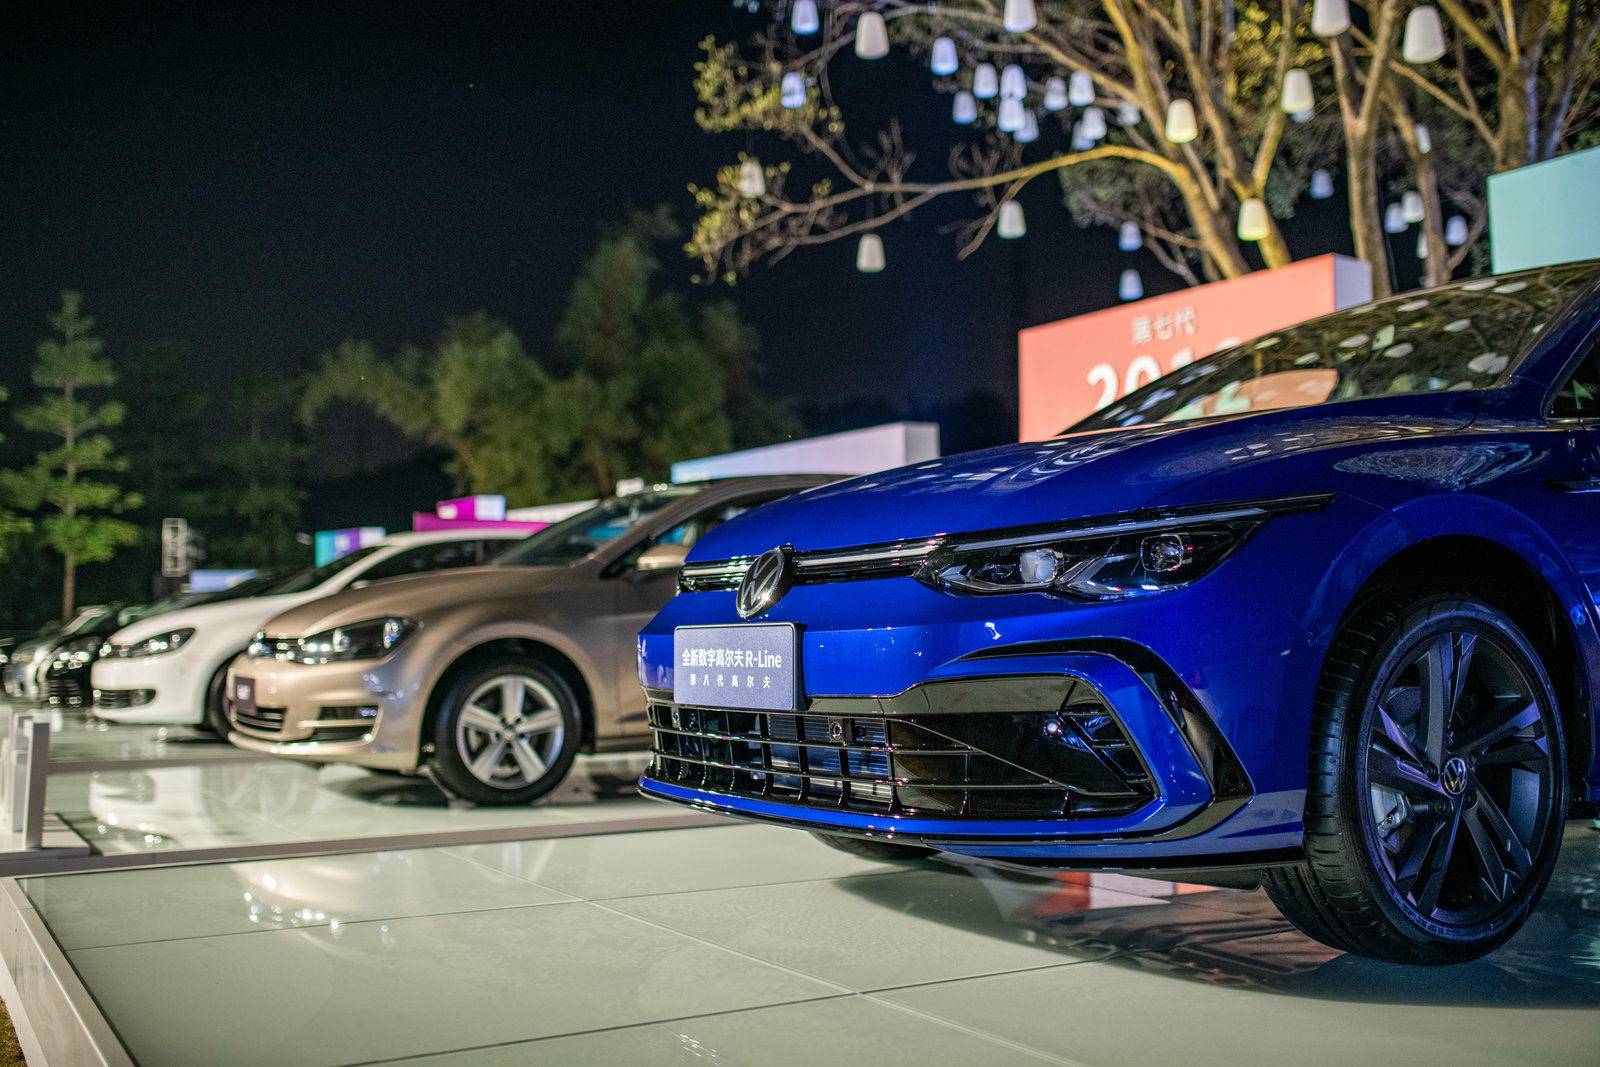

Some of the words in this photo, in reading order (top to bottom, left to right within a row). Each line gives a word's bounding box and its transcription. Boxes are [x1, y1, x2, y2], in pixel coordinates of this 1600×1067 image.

[682, 648, 744, 667] 全新数字高尔夫
[745, 650, 782, 668] R-Line
